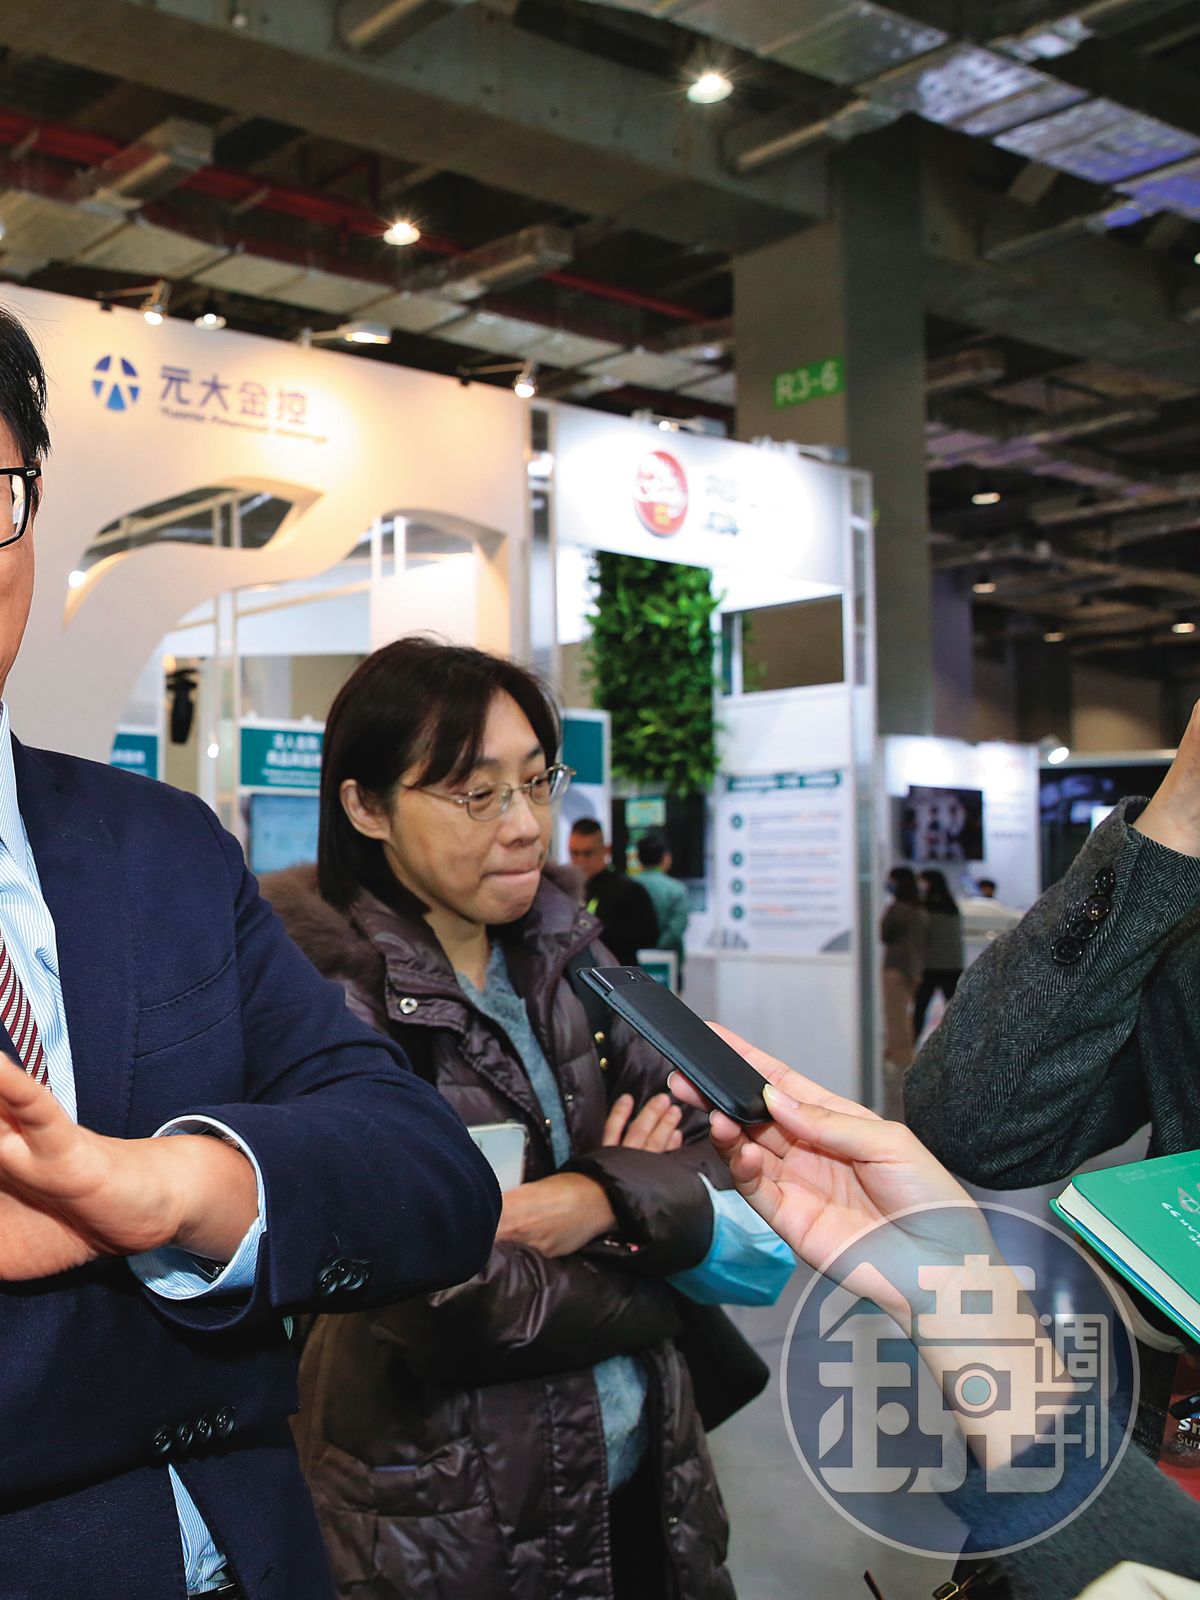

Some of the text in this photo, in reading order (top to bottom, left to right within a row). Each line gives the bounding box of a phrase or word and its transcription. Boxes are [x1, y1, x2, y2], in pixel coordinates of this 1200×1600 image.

[160, 365, 307, 424] 元大金控
[776, 360, 839, 406] R3-6
